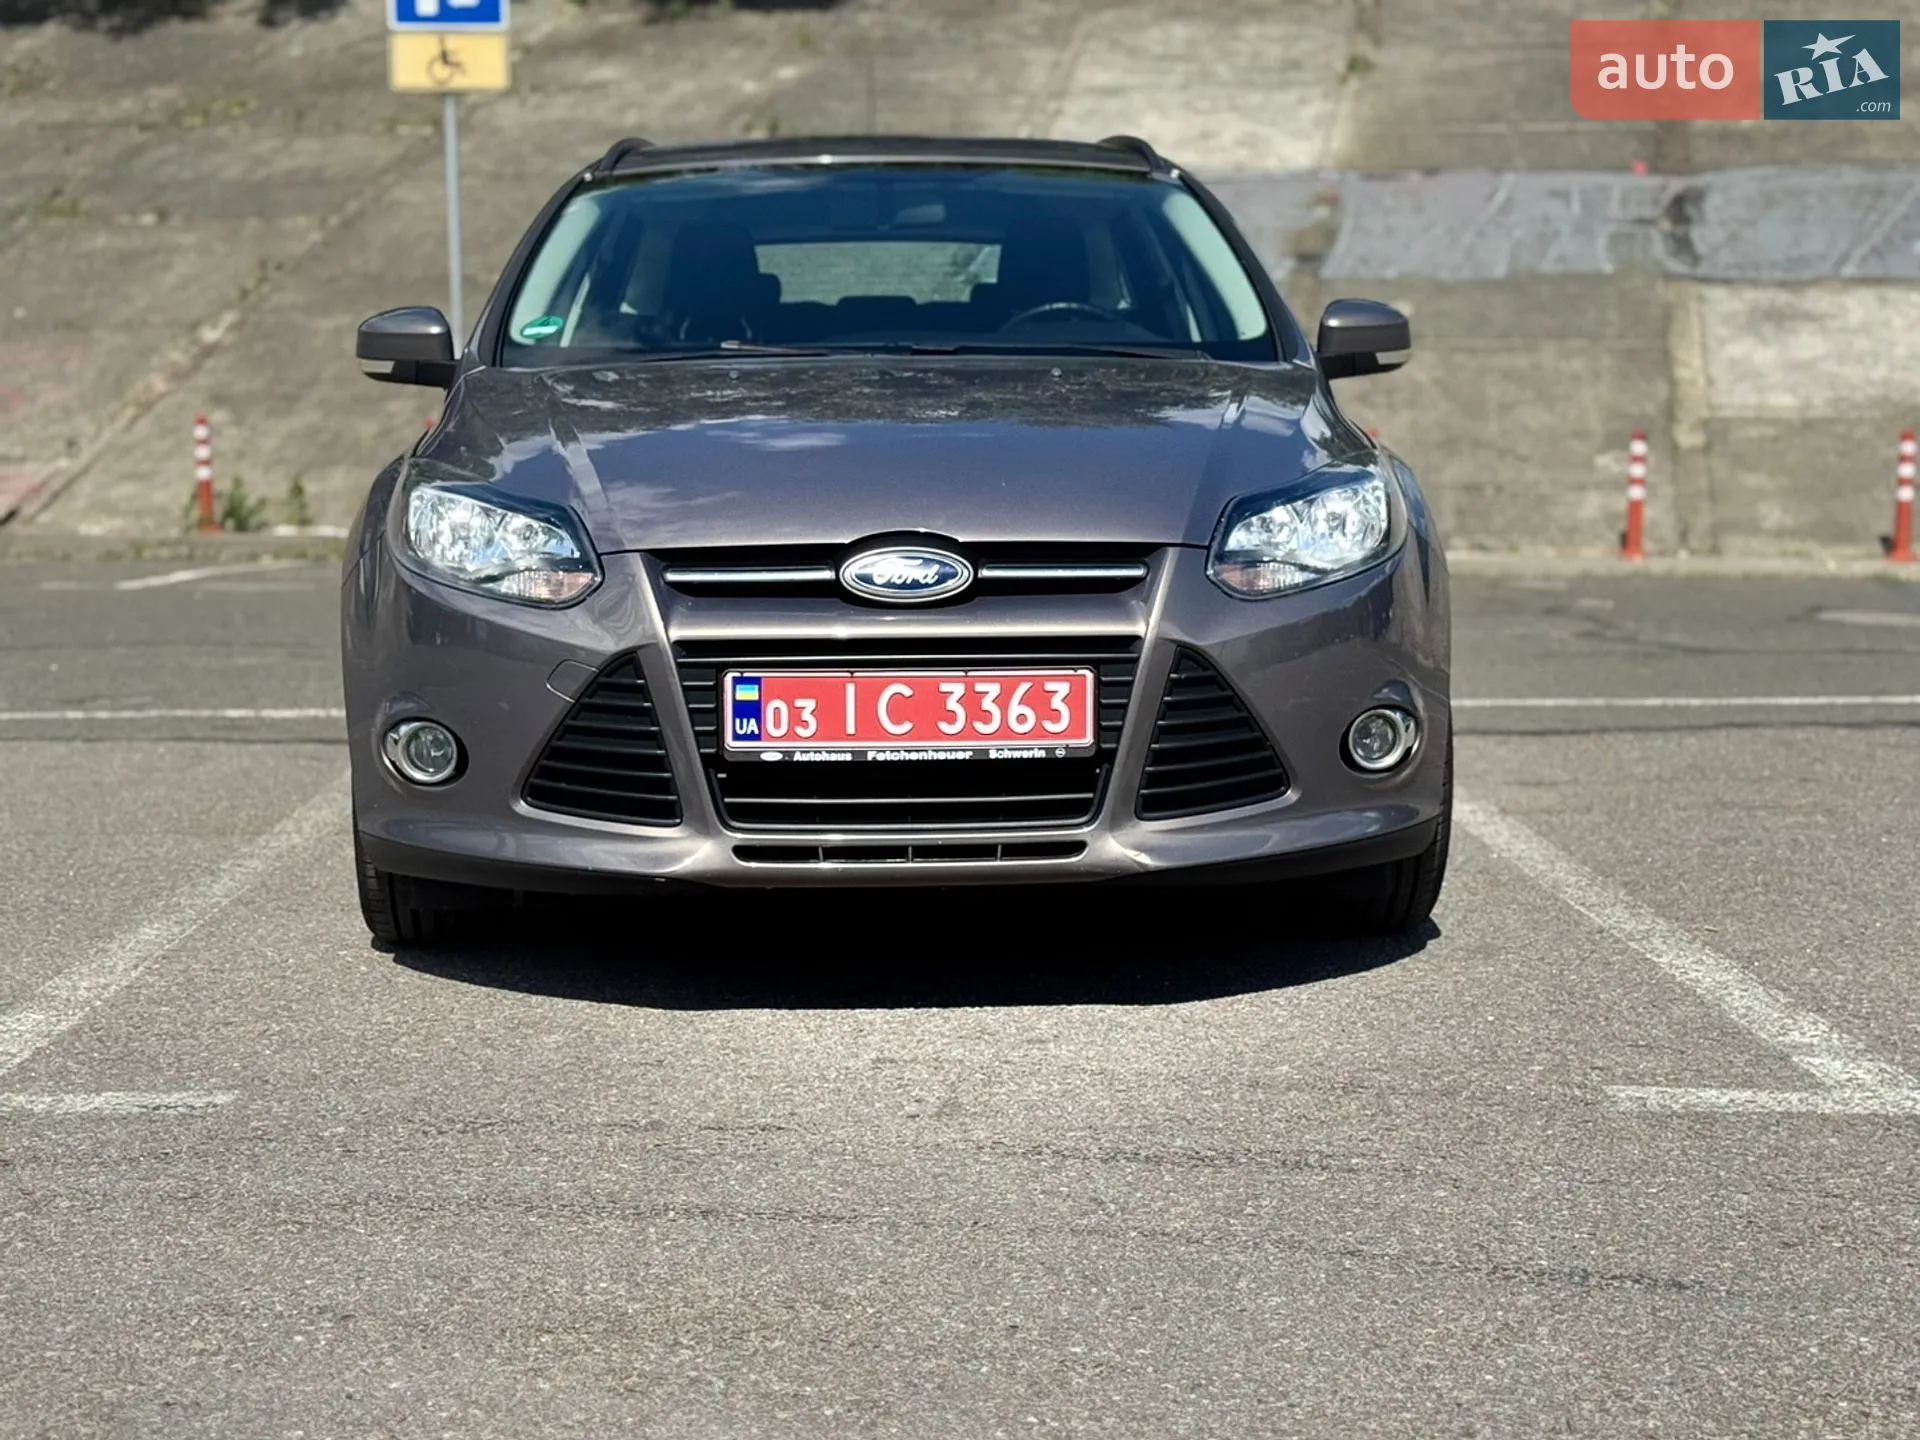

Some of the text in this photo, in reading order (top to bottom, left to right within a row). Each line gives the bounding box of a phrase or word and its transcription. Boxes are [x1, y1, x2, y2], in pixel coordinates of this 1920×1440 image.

[872, 557, 939, 585] Ford
[765, 698, 818, 739] 03
[936, 681, 1071, 735] 3363
[735, 718, 759, 735] UA
[793, 750, 853, 761] Autohaus
[988, 748, 1046, 759] Schwerin
